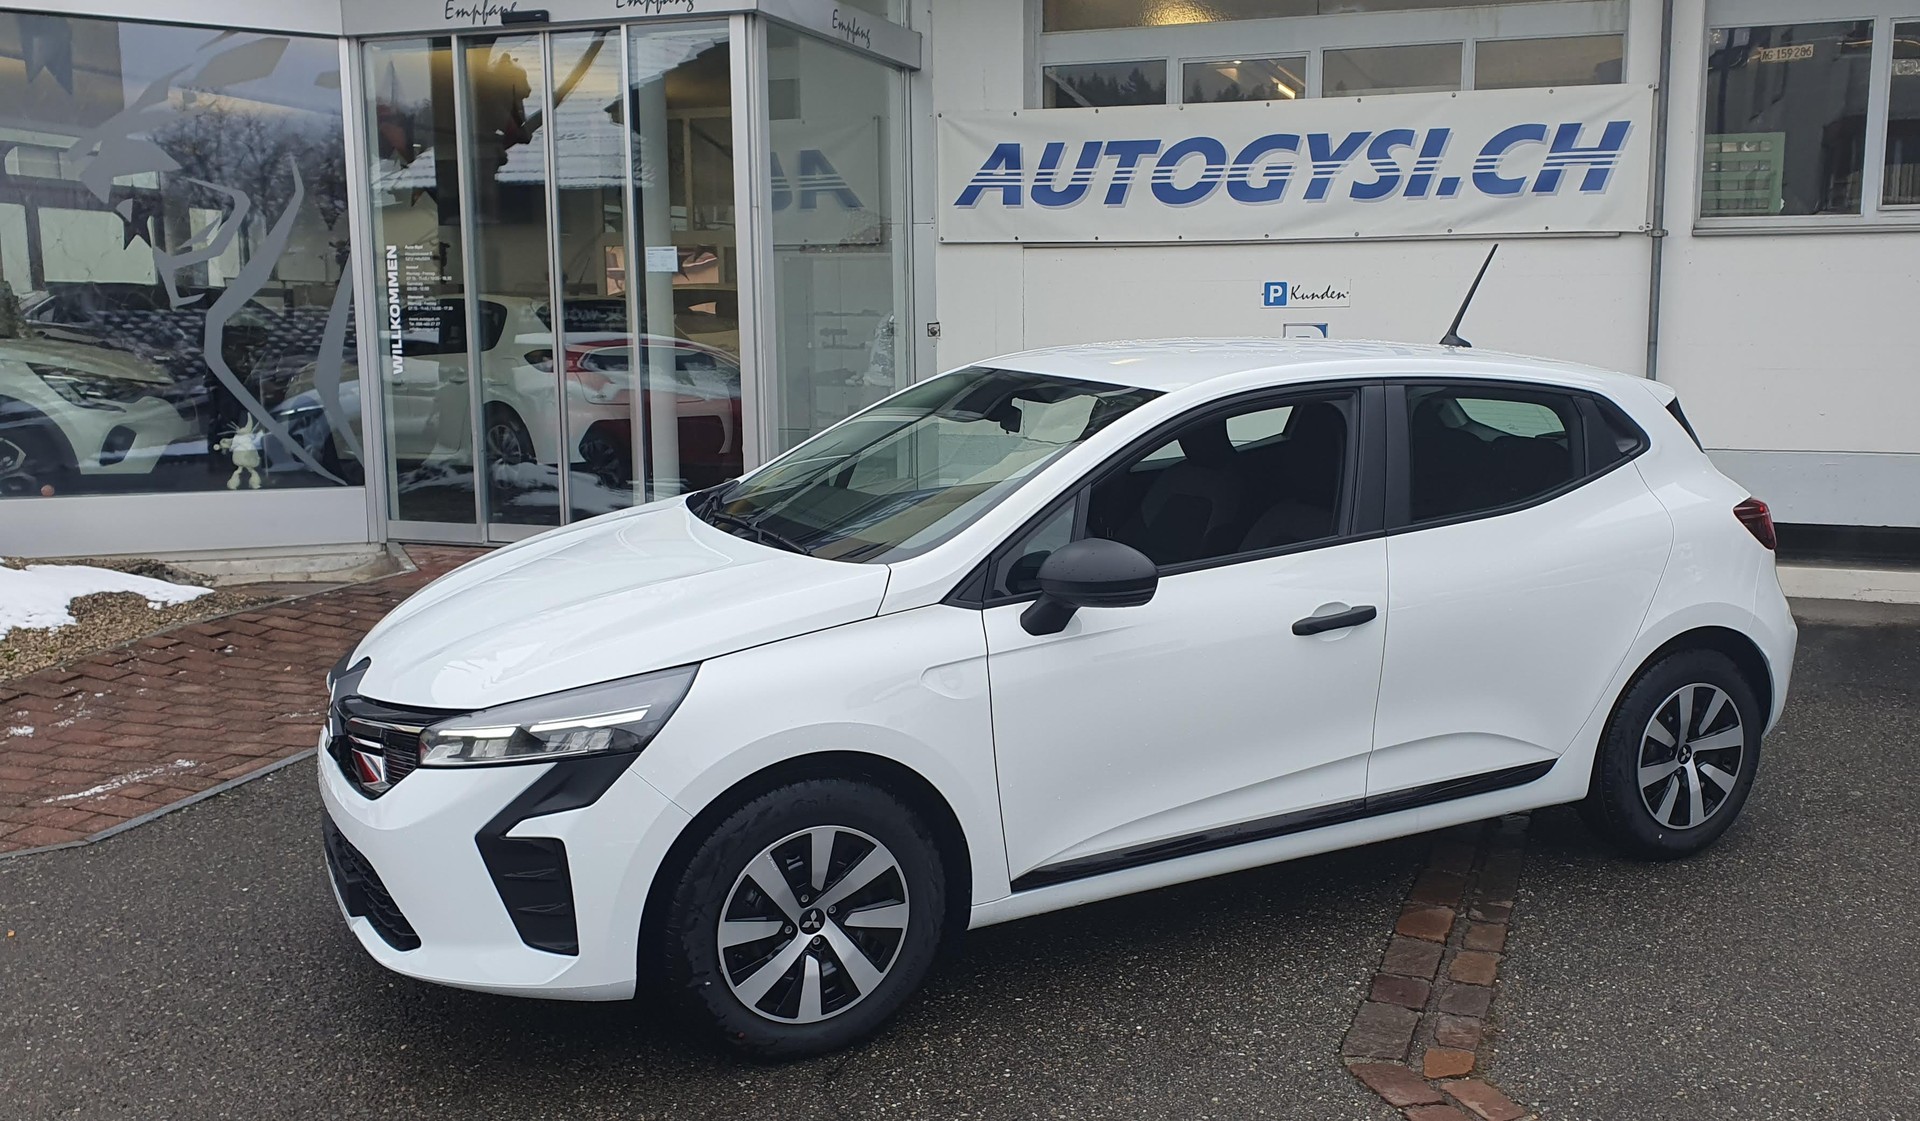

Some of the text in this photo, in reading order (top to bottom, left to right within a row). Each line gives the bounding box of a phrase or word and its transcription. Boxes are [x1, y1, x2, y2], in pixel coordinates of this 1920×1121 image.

[832, 9, 870, 49] Empfang
[953, 121, 1634, 208] AUTOGYSI.CH
[386, 245, 404, 375] WILLKOMMEN
[1290, 285, 1346, 300] Kunden
